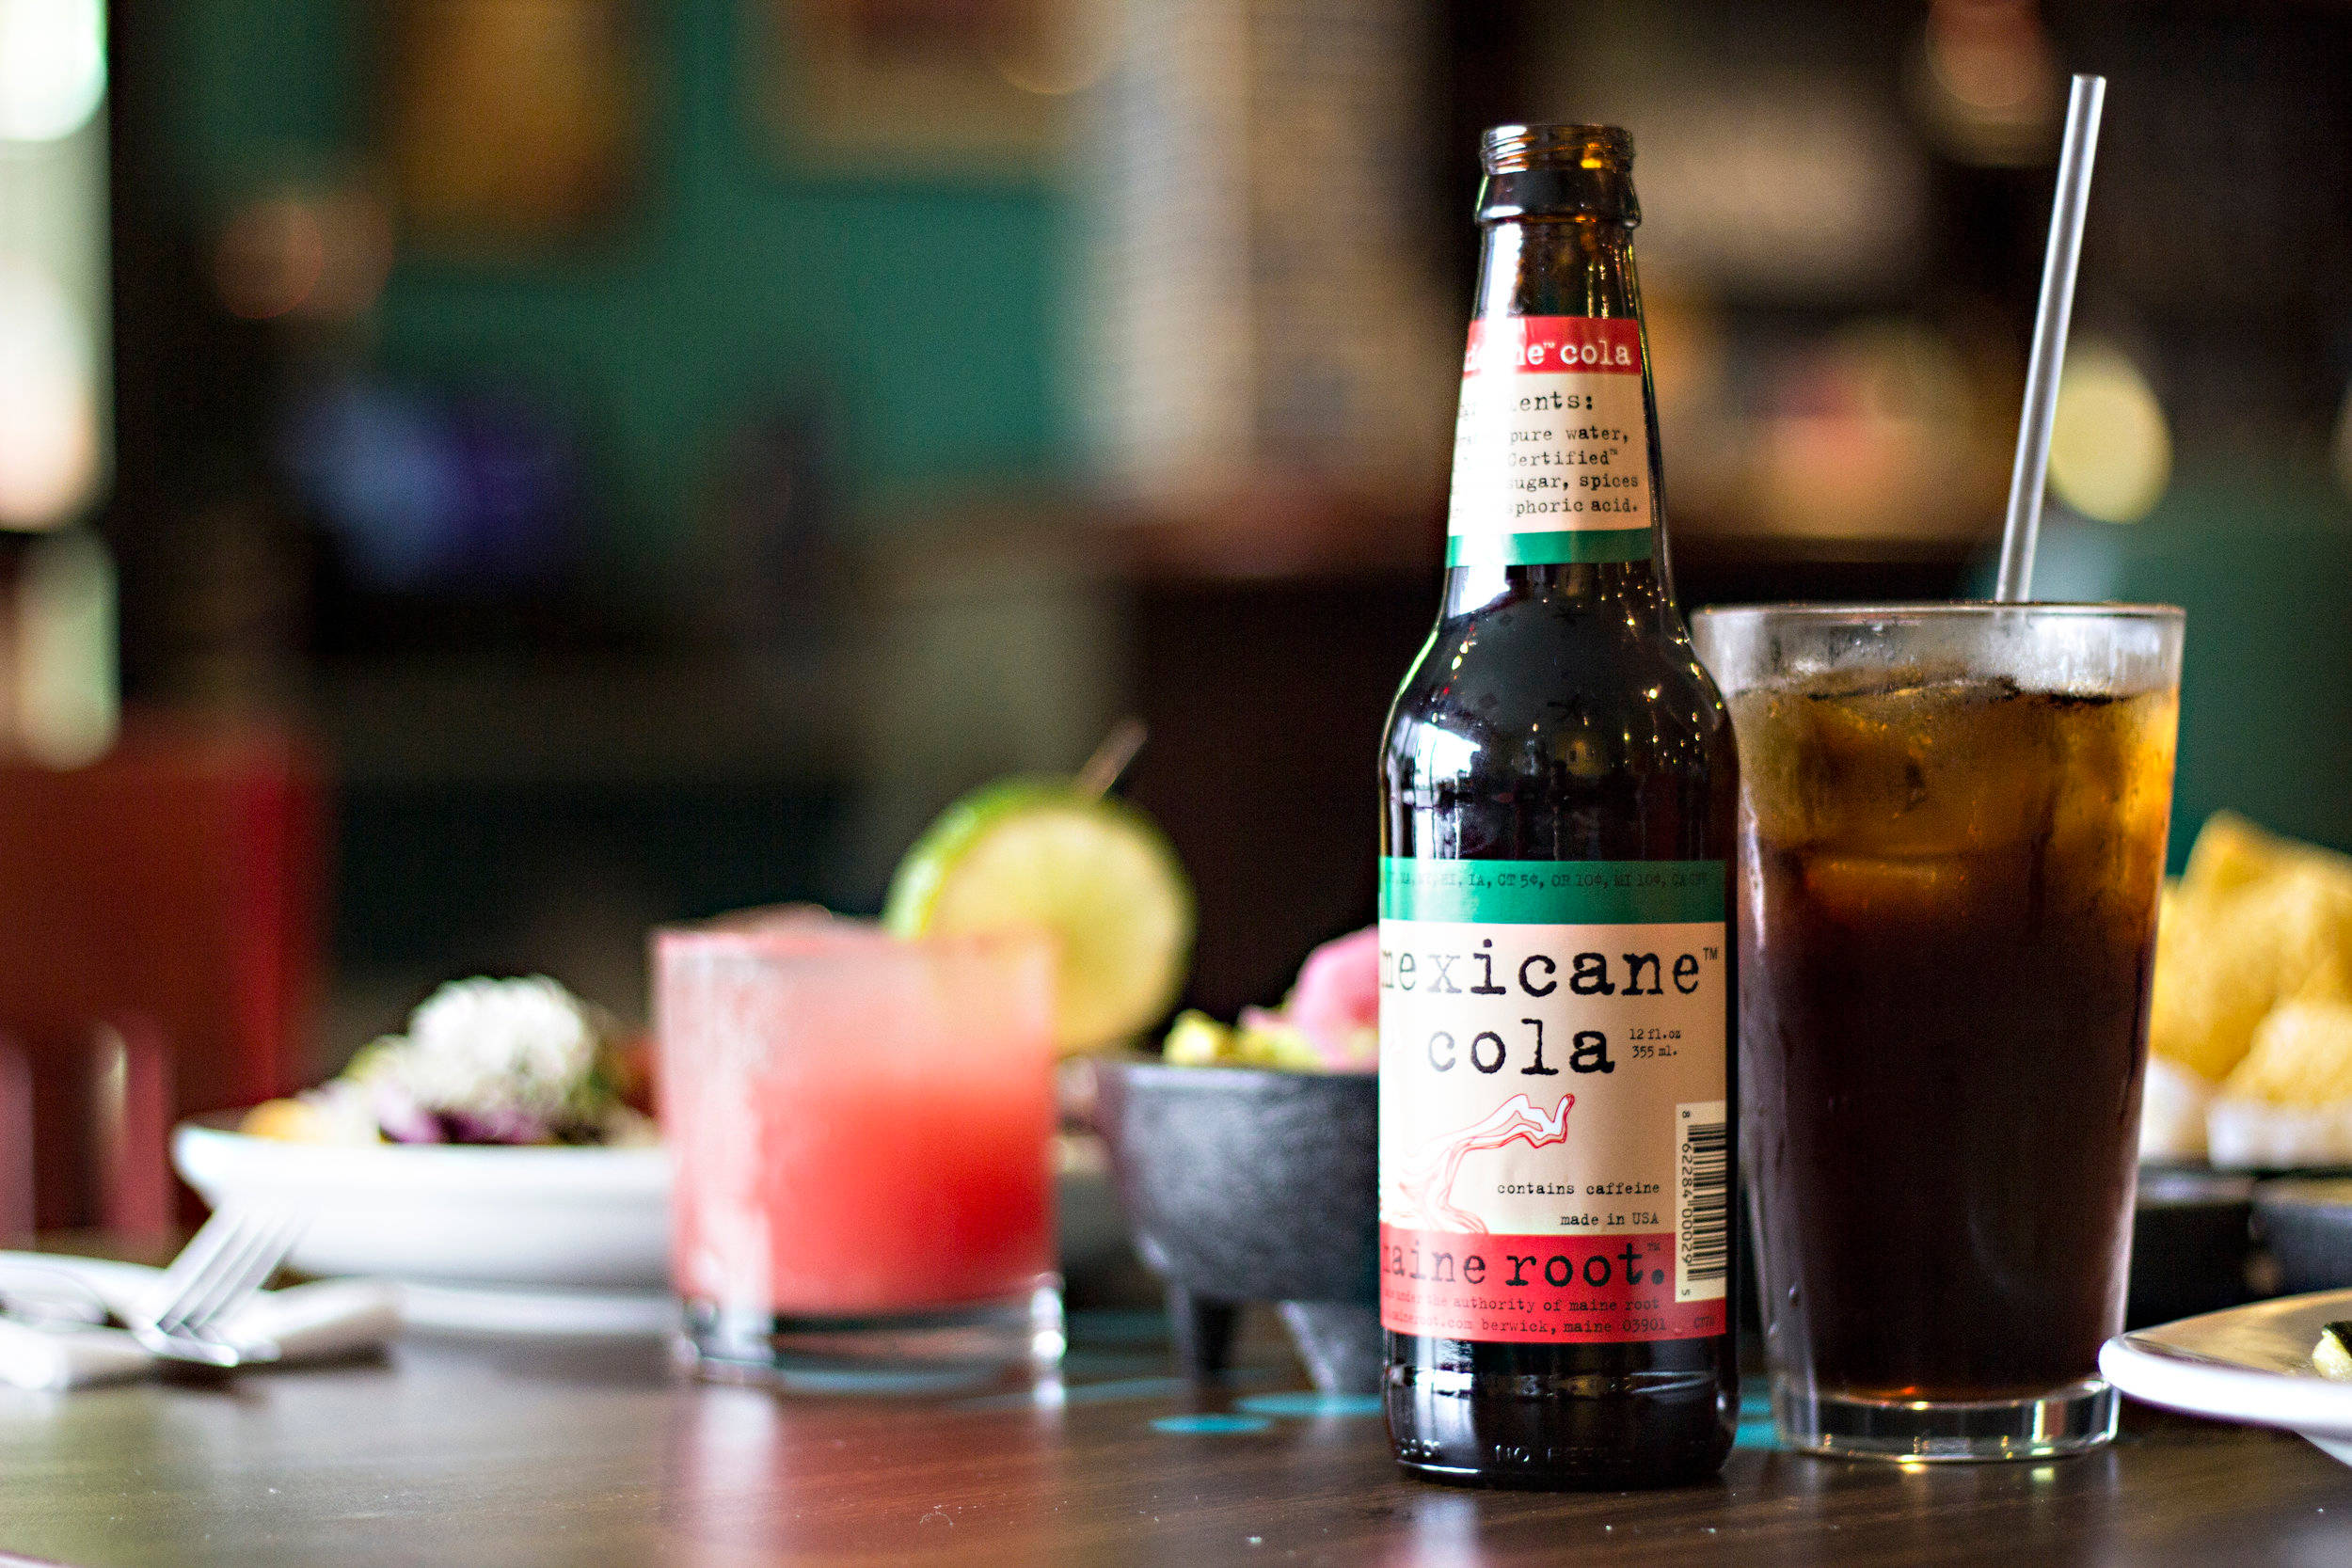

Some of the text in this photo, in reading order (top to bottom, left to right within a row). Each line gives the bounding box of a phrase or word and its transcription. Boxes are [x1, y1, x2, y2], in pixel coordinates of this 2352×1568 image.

[1559, 339, 1631, 367] cola
[1510, 425, 1629, 446] pure water,
[1579, 473, 1639, 491] spices
[1590, 497, 1638, 514] acid.
[1497, 873, 1518, 888] CT
[1629, 1028, 1645, 1040] 12
[1428, 1018, 1615, 1076] cola
[1632, 1045, 1678, 1058] 355 ml.
[1497, 1181, 1660, 1196] contains caffeine
[1561, 1212, 1660, 1226] made in USA
[1453, 1297, 1535, 1314] authority
[1543, 1297, 1565, 1312] of
[1568, 1298, 1617, 1312] maine
[1625, 1298, 1660, 1311] root
[1481, 1317, 1556, 1336] berwick,
[1563, 1319, 1613, 1333] maine
[1622, 1318, 1667, 1332] 03901
